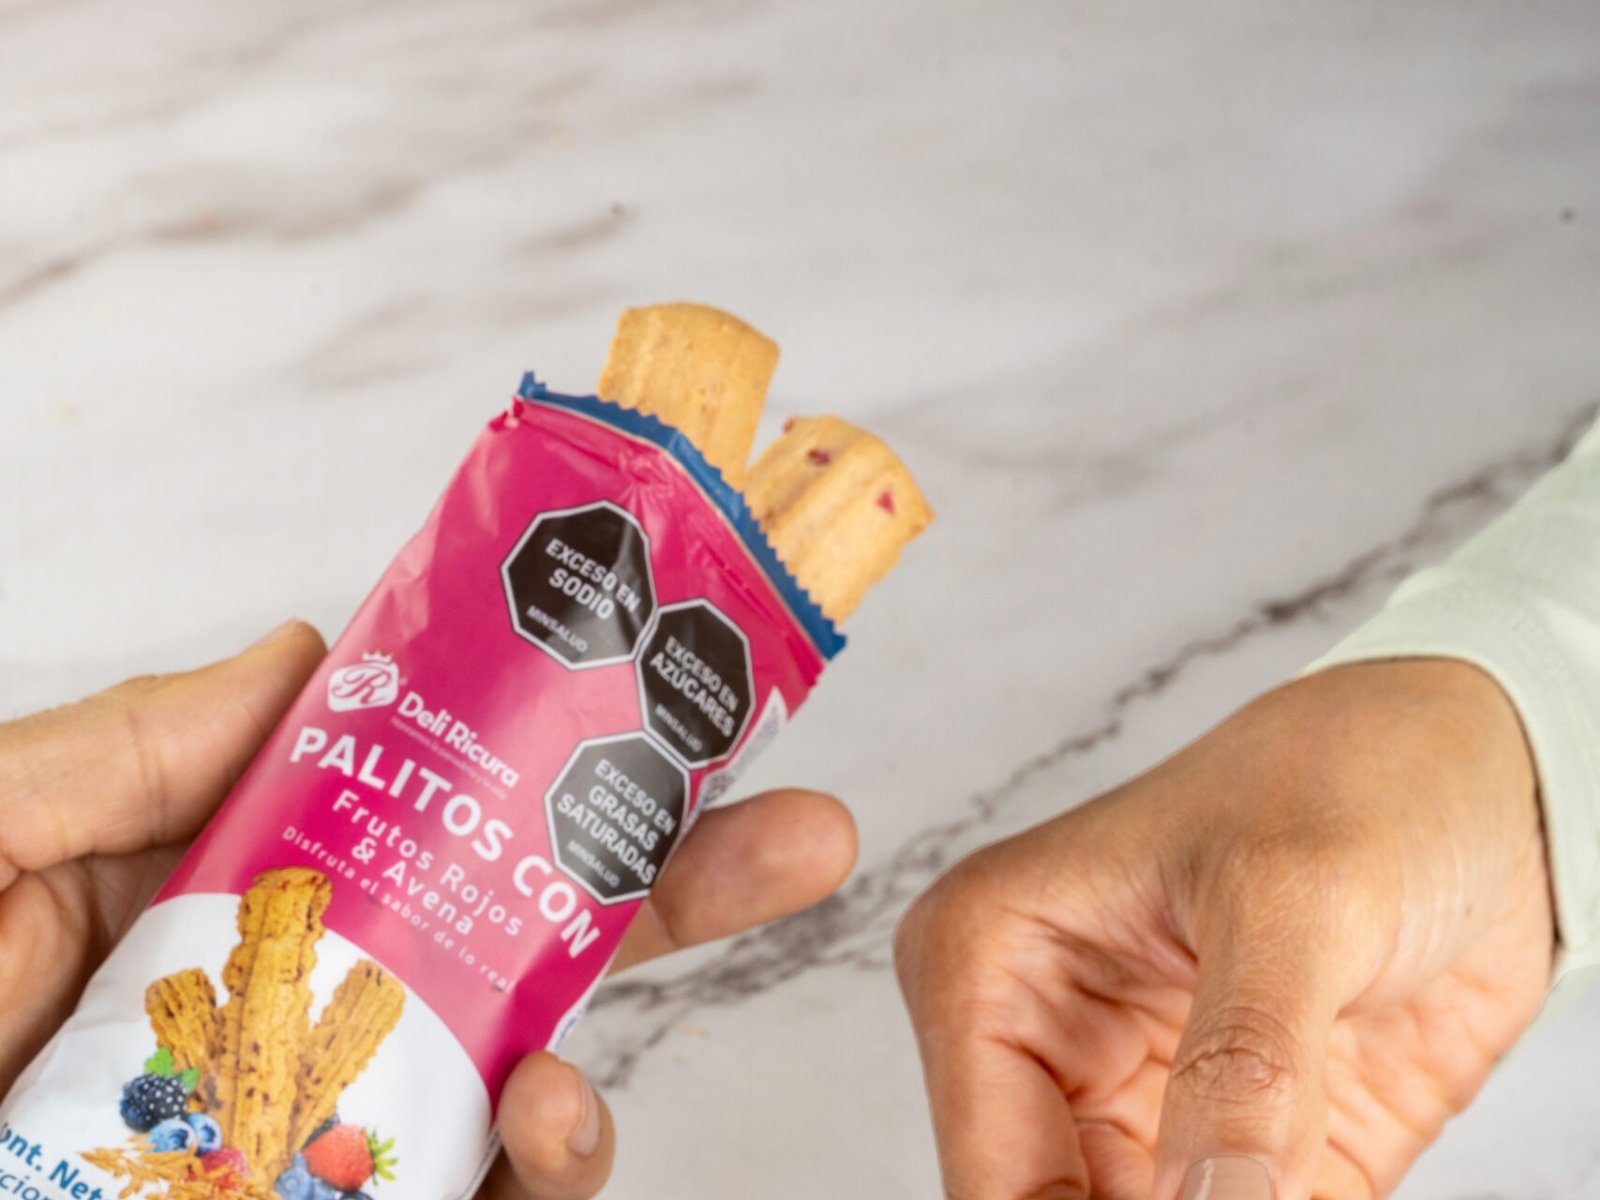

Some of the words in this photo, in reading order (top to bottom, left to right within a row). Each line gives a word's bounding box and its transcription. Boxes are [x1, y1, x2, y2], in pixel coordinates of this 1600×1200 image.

[545, 538, 617, 591] EXCESO
[615, 583, 641, 612] EN
[549, 568, 615, 620] SODIO
[526, 605, 589, 653] MINSALUD
[664, 635, 720, 690] EXCESO
[719, 684, 738, 712] EN
[397, 691, 452, 737] Deli
[444, 721, 520, 788] Ricura
[588, 785, 659, 852] GRASAS
[594, 758, 656, 817] EXCESO
[653, 809, 677, 836] EN
[289, 726, 514, 862] PALITOS
[513, 855, 600, 959] CON
[333, 790, 434, 871] Frutos
[439, 864, 523, 936] Rojos
[556, 793, 656, 884] SATURADAS
[282, 825, 355, 879] Disfruta
[359, 874, 379, 895] el
[381, 893, 429, 931] sabor
[433, 928, 454, 950] de
[351, 837, 377, 865] &
[382, 860, 474, 936] Avena
[0, 1124, 43, 1172] ont.
